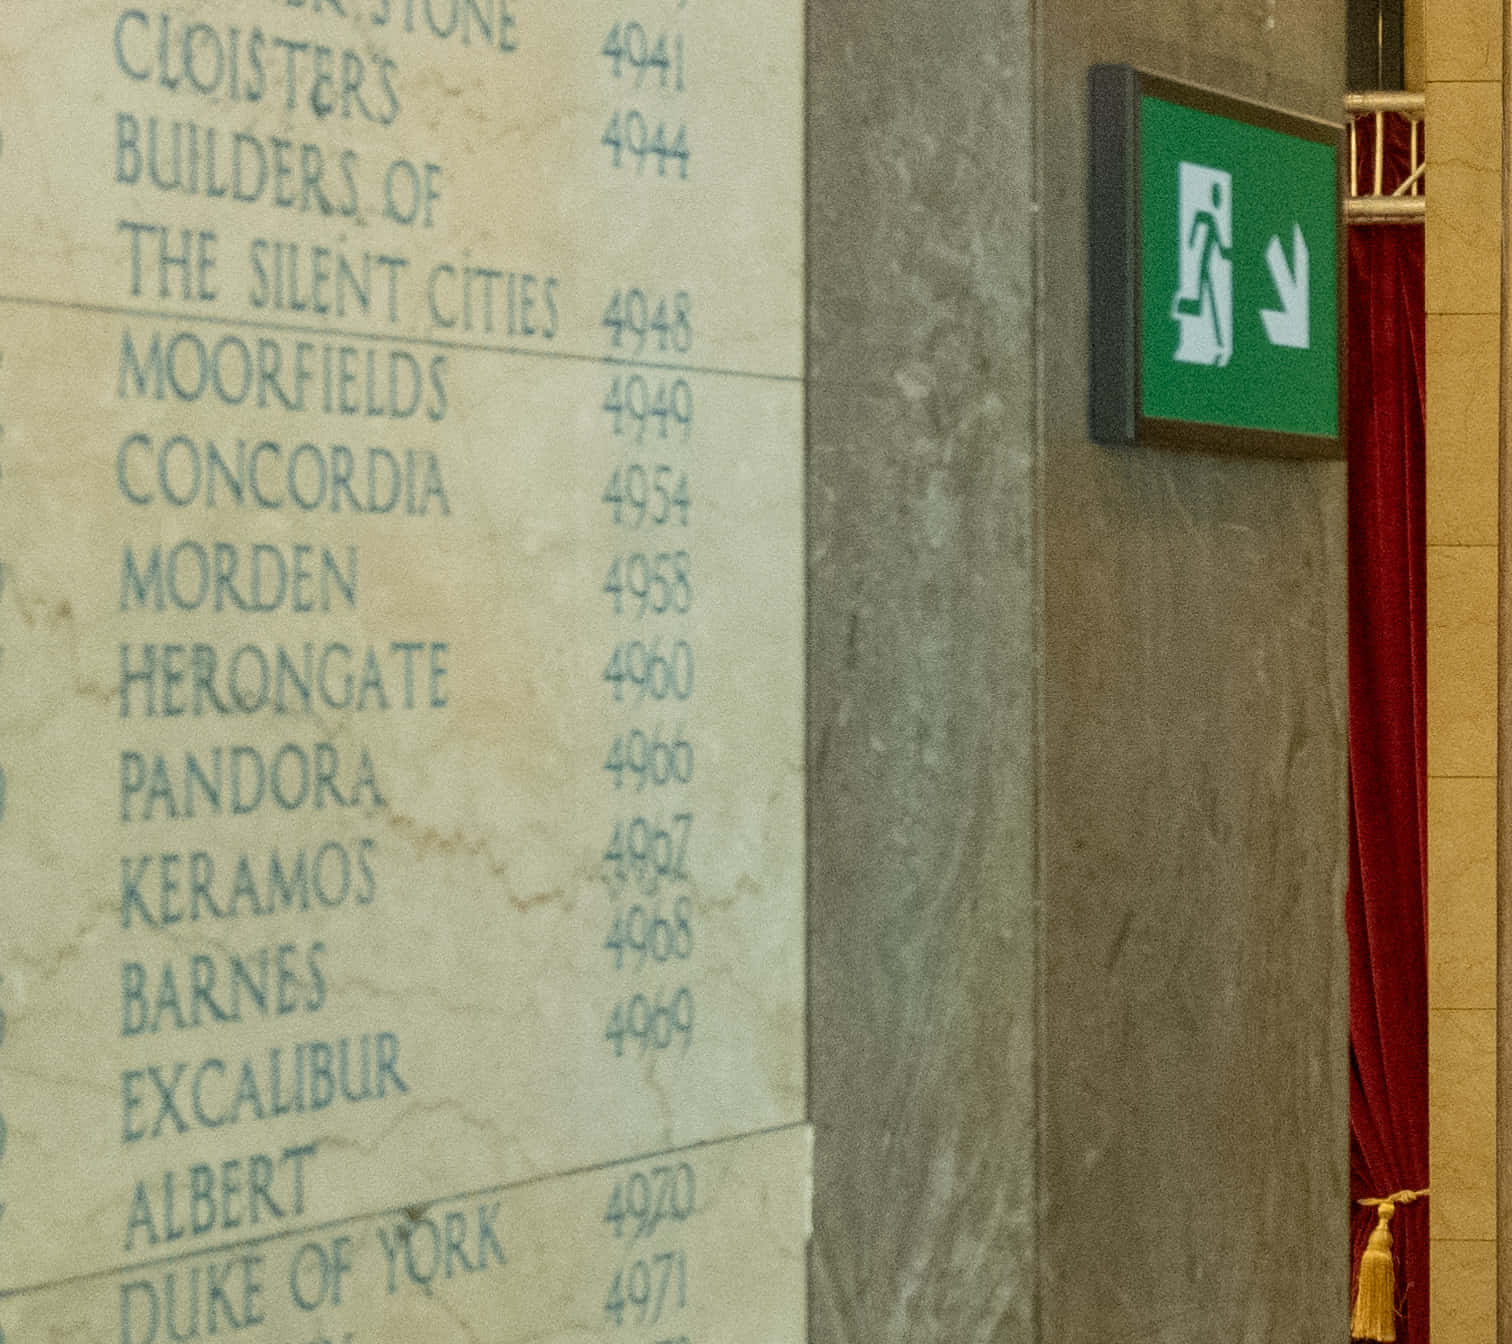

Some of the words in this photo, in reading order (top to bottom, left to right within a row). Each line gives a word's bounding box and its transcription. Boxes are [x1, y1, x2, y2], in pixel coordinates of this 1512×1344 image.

[113, 7, 401, 131] CLOISTERS
[600, 110, 692, 183] 4944
[600, 20, 687, 94] 4941
[114, 112, 360, 220] BUILDERS
[382, 155, 443, 229] OF
[115, 219, 216, 306] THE
[249, 236, 410, 323] SILENT
[426, 264, 560, 341] CITIES
[601, 287, 695, 357] 4948
[117, 329, 450, 424] MOORFIELDS
[602, 373, 696, 445] 4949
[116, 431, 452, 517] CONCORDIA
[602, 460, 694, 531] 4954
[119, 538, 359, 614] MORDEN
[117, 640, 450, 719] HERONGATE
[604, 641, 696, 706] 4960
[120, 742, 386, 822] PANDORA
[120, 837, 380, 931] KERAMOS
[120, 941, 329, 1039] BARNES
[604, 896, 696, 978] 4968
[120, 1030, 410, 1144] EXCALIBUR
[605, 984, 698, 1062] 4969
[123, 1142, 319, 1251] ALBERT
[289, 1236, 354, 1313] OF
[377, 1201, 508, 1295] YORK
[602, 1160, 698, 1244] 4970
[603, 1249, 690, 1328] 4971
